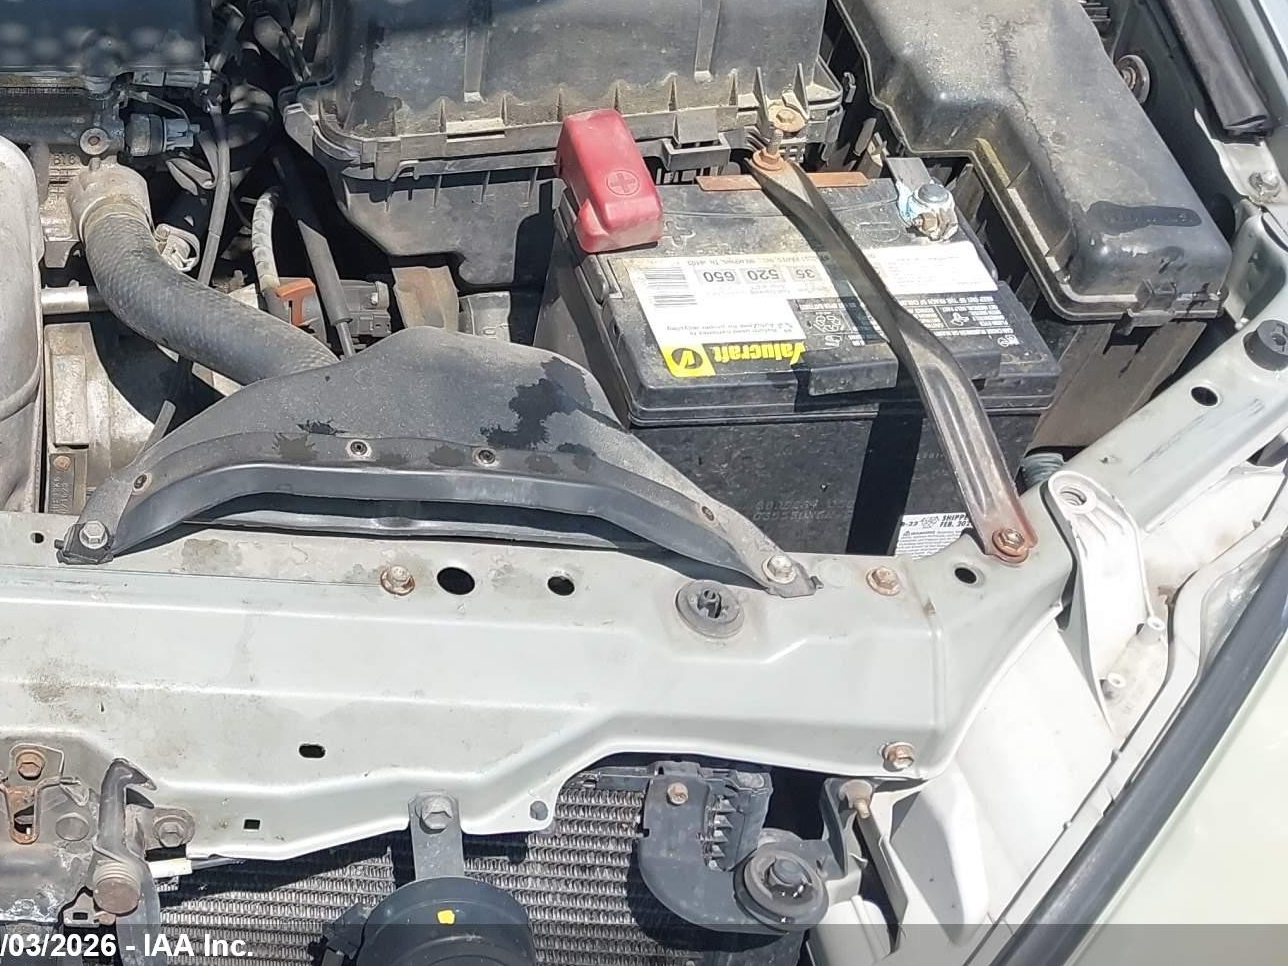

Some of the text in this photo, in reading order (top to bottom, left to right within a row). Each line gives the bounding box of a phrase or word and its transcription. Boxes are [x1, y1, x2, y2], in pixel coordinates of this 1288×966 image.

[703, 268, 815, 283] 35 520 650
[713, 341, 806, 365] Valucraft
